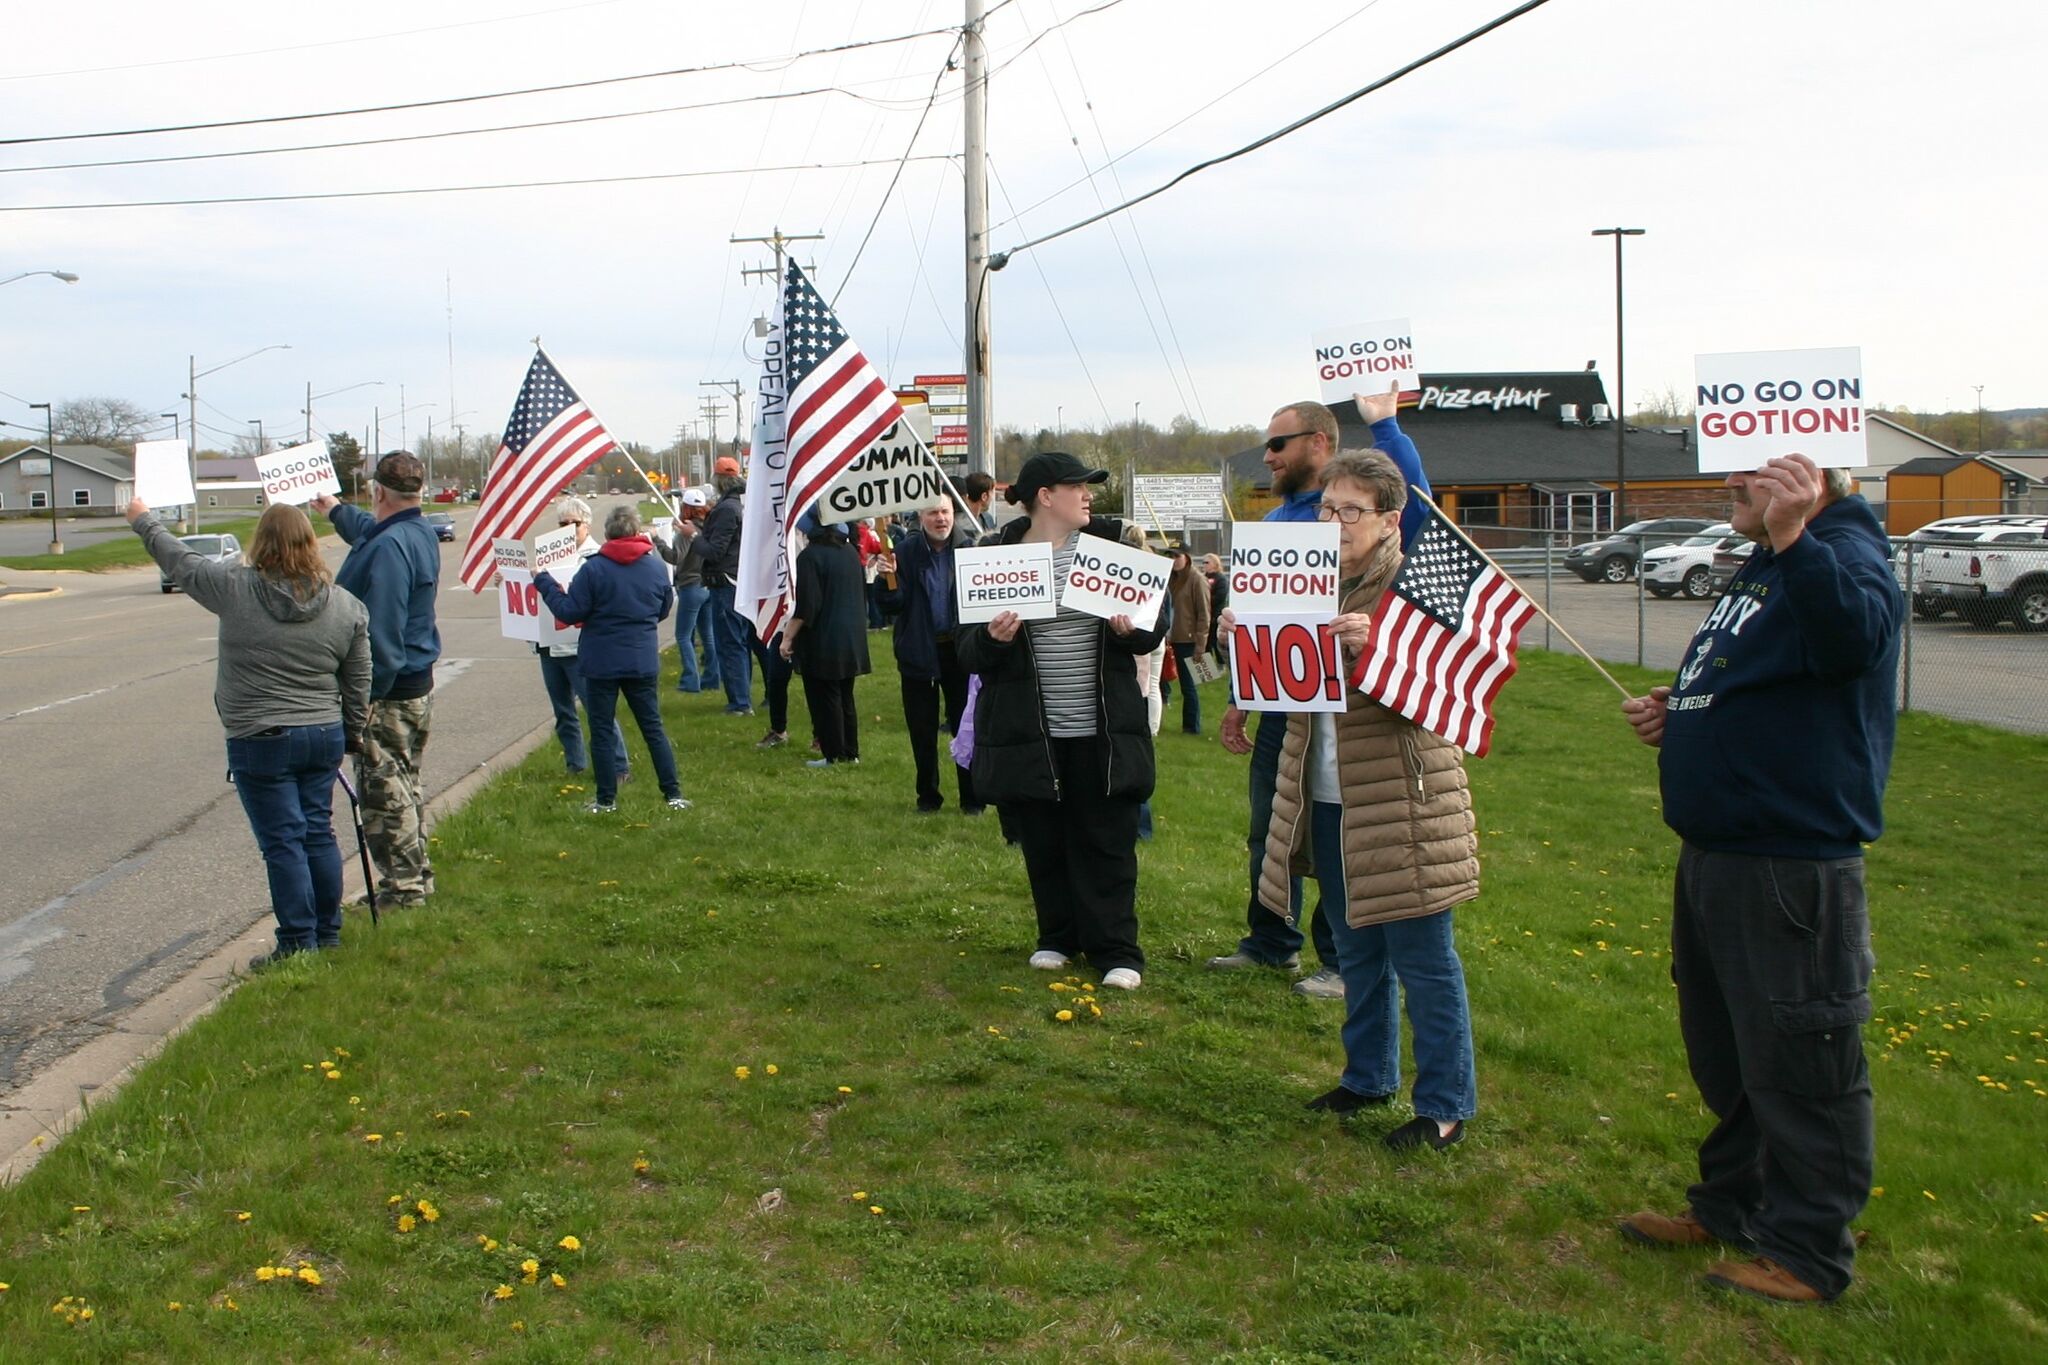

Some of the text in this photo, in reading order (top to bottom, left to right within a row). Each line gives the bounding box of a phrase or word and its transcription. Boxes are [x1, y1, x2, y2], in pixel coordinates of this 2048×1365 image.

[1316, 336, 1412, 361] NO GO ON
[1320, 353, 1414, 380] GOTION!
[1697, 378, 1861, 406] NO GO ON
[1701, 407, 1860, 438] GOTION!
[260, 454, 330, 481] NO GO ON
[267, 467, 334, 494] GOTION!
[829, 470, 942, 512] GOTION
[535, 535, 576, 556] NO GO ON
[537, 546, 576, 567] GOTION!
[1232, 548, 1337, 568] NO GO ON
[971, 570, 1039, 586] CHOOSE
[1073, 552, 1166, 591] NO GO ON
[1232, 572, 1335, 596] GOTION!
[968, 585, 1045, 601] FREEDOM
[1695, 594, 1762, 636] AVY
[1234, 624, 1341, 702] NO!
